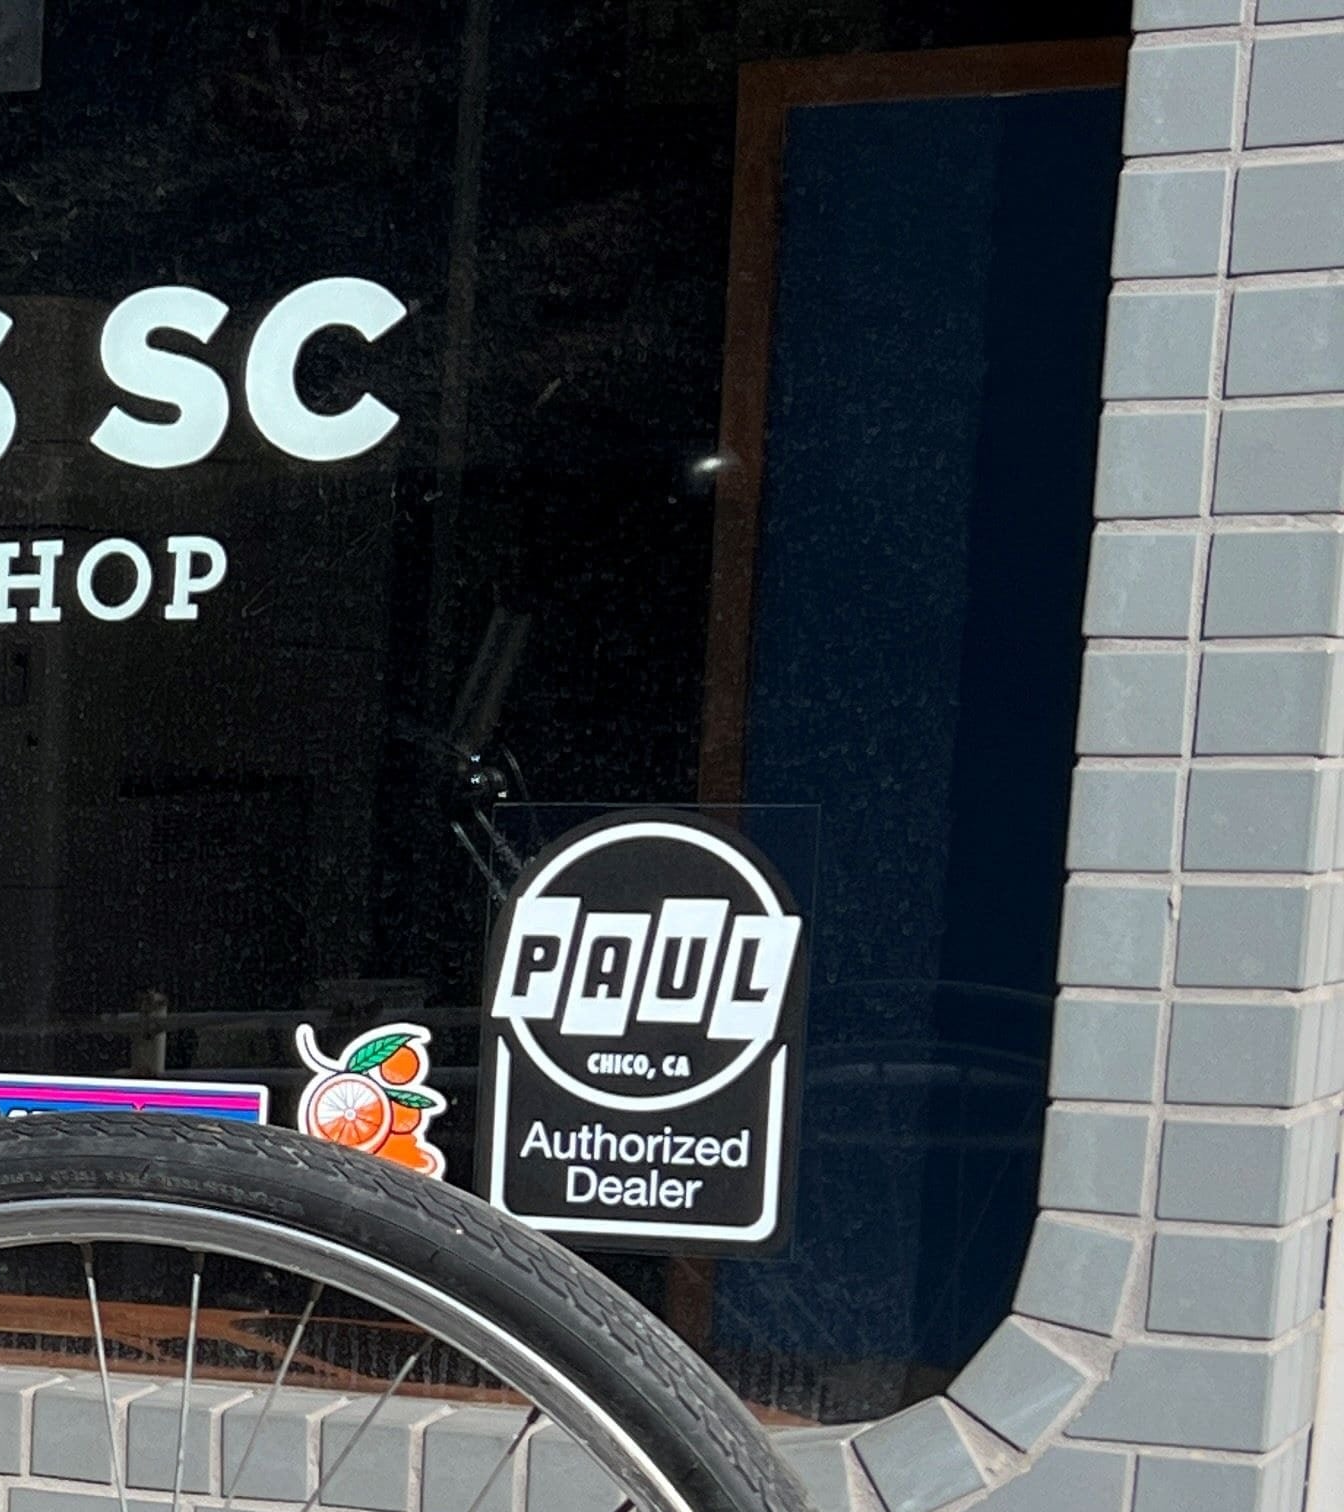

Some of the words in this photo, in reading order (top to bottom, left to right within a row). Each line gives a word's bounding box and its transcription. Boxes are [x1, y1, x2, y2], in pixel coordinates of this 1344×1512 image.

[90, 277, 407, 469] SC
[586, 1052, 656, 1080] CHICO,
[661, 1055, 691, 1077] CA
[519, 1121, 750, 1168] Authorized
[566, 1165, 704, 1209] Dealer
